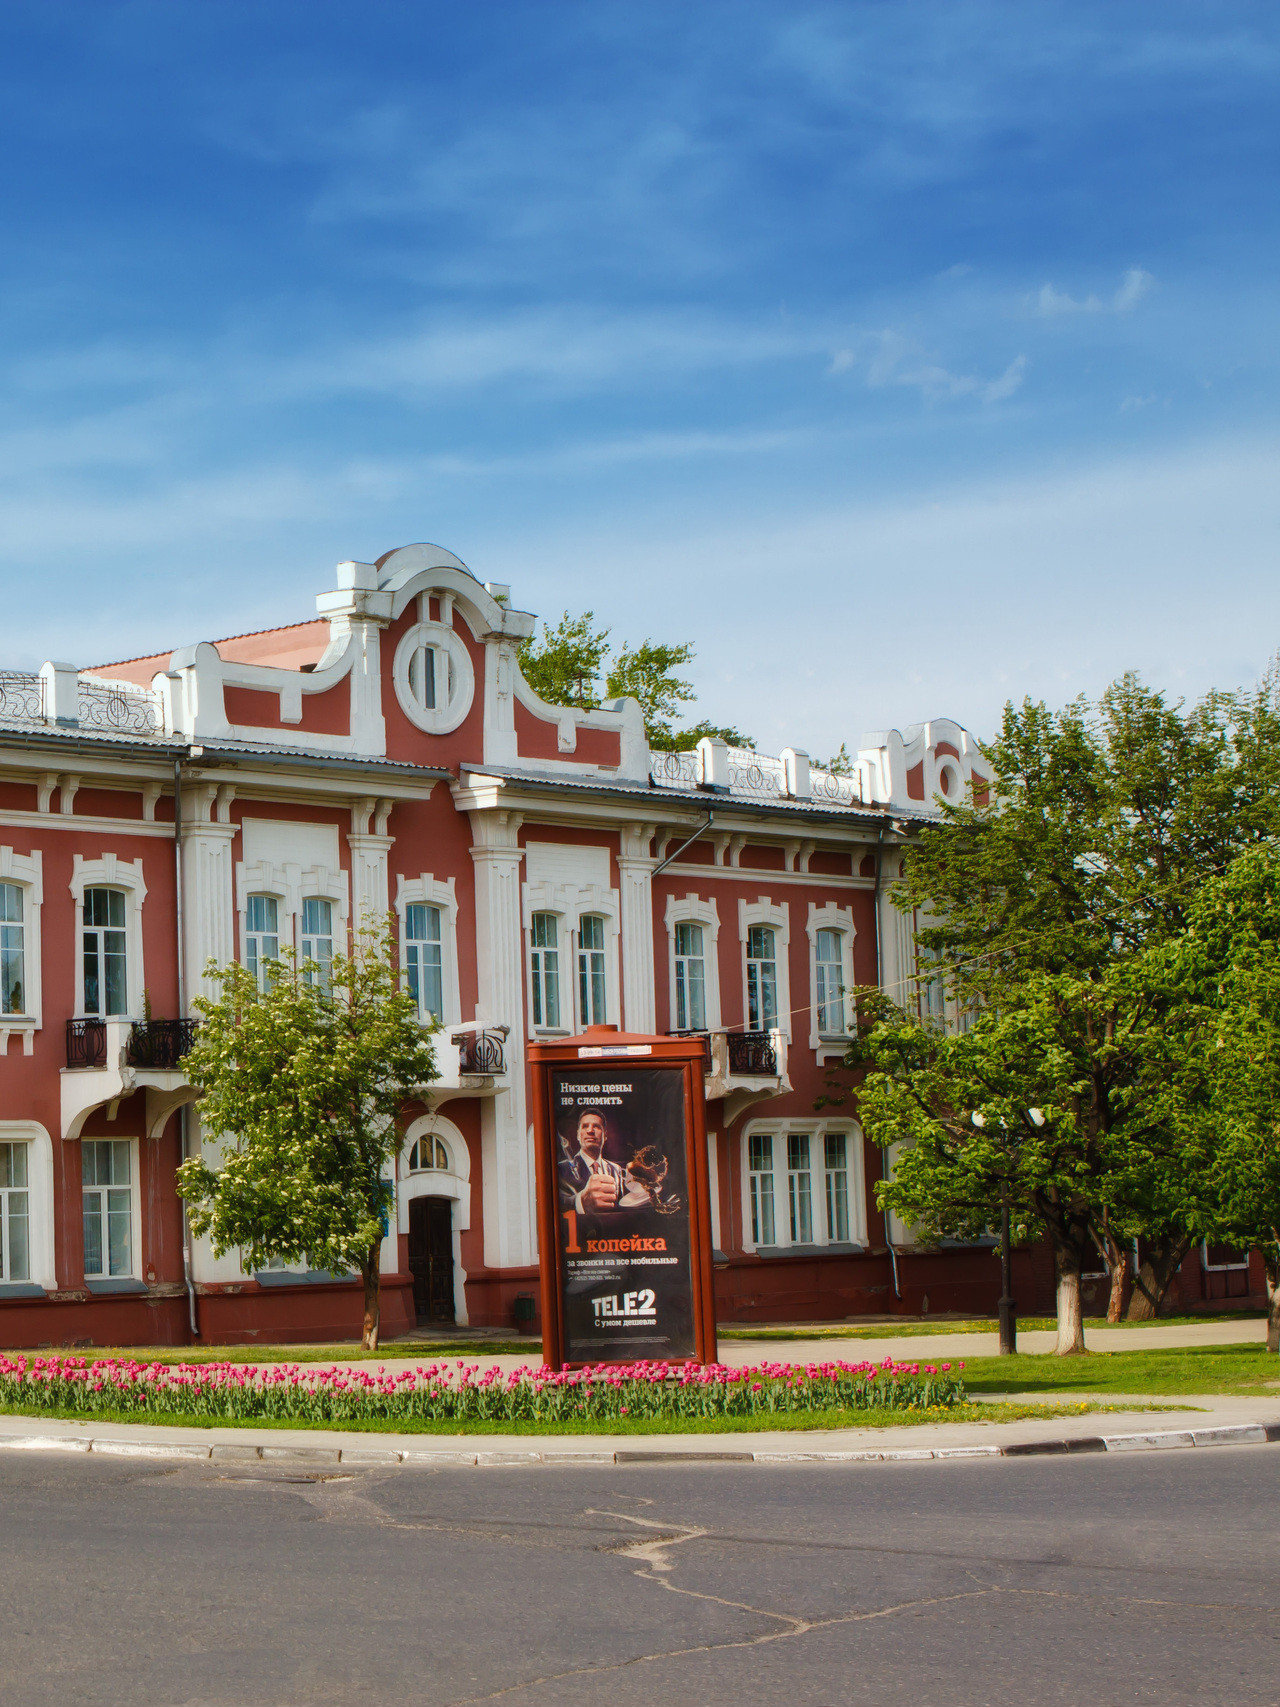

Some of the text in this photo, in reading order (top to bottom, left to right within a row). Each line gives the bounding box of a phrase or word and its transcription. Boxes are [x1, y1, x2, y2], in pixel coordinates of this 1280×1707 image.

[560, 1082, 632, 1094] Низкие цены
[561, 1096, 623, 1105] не сломить
[563, 1210, 667, 1253] 1 копейка
[605, 1259, 615, 1267] на
[630, 1257, 678, 1265] мобильные
[591, 1288, 657, 1316] TELE2
[594, 1318, 657, 1328] С умом дешевле
